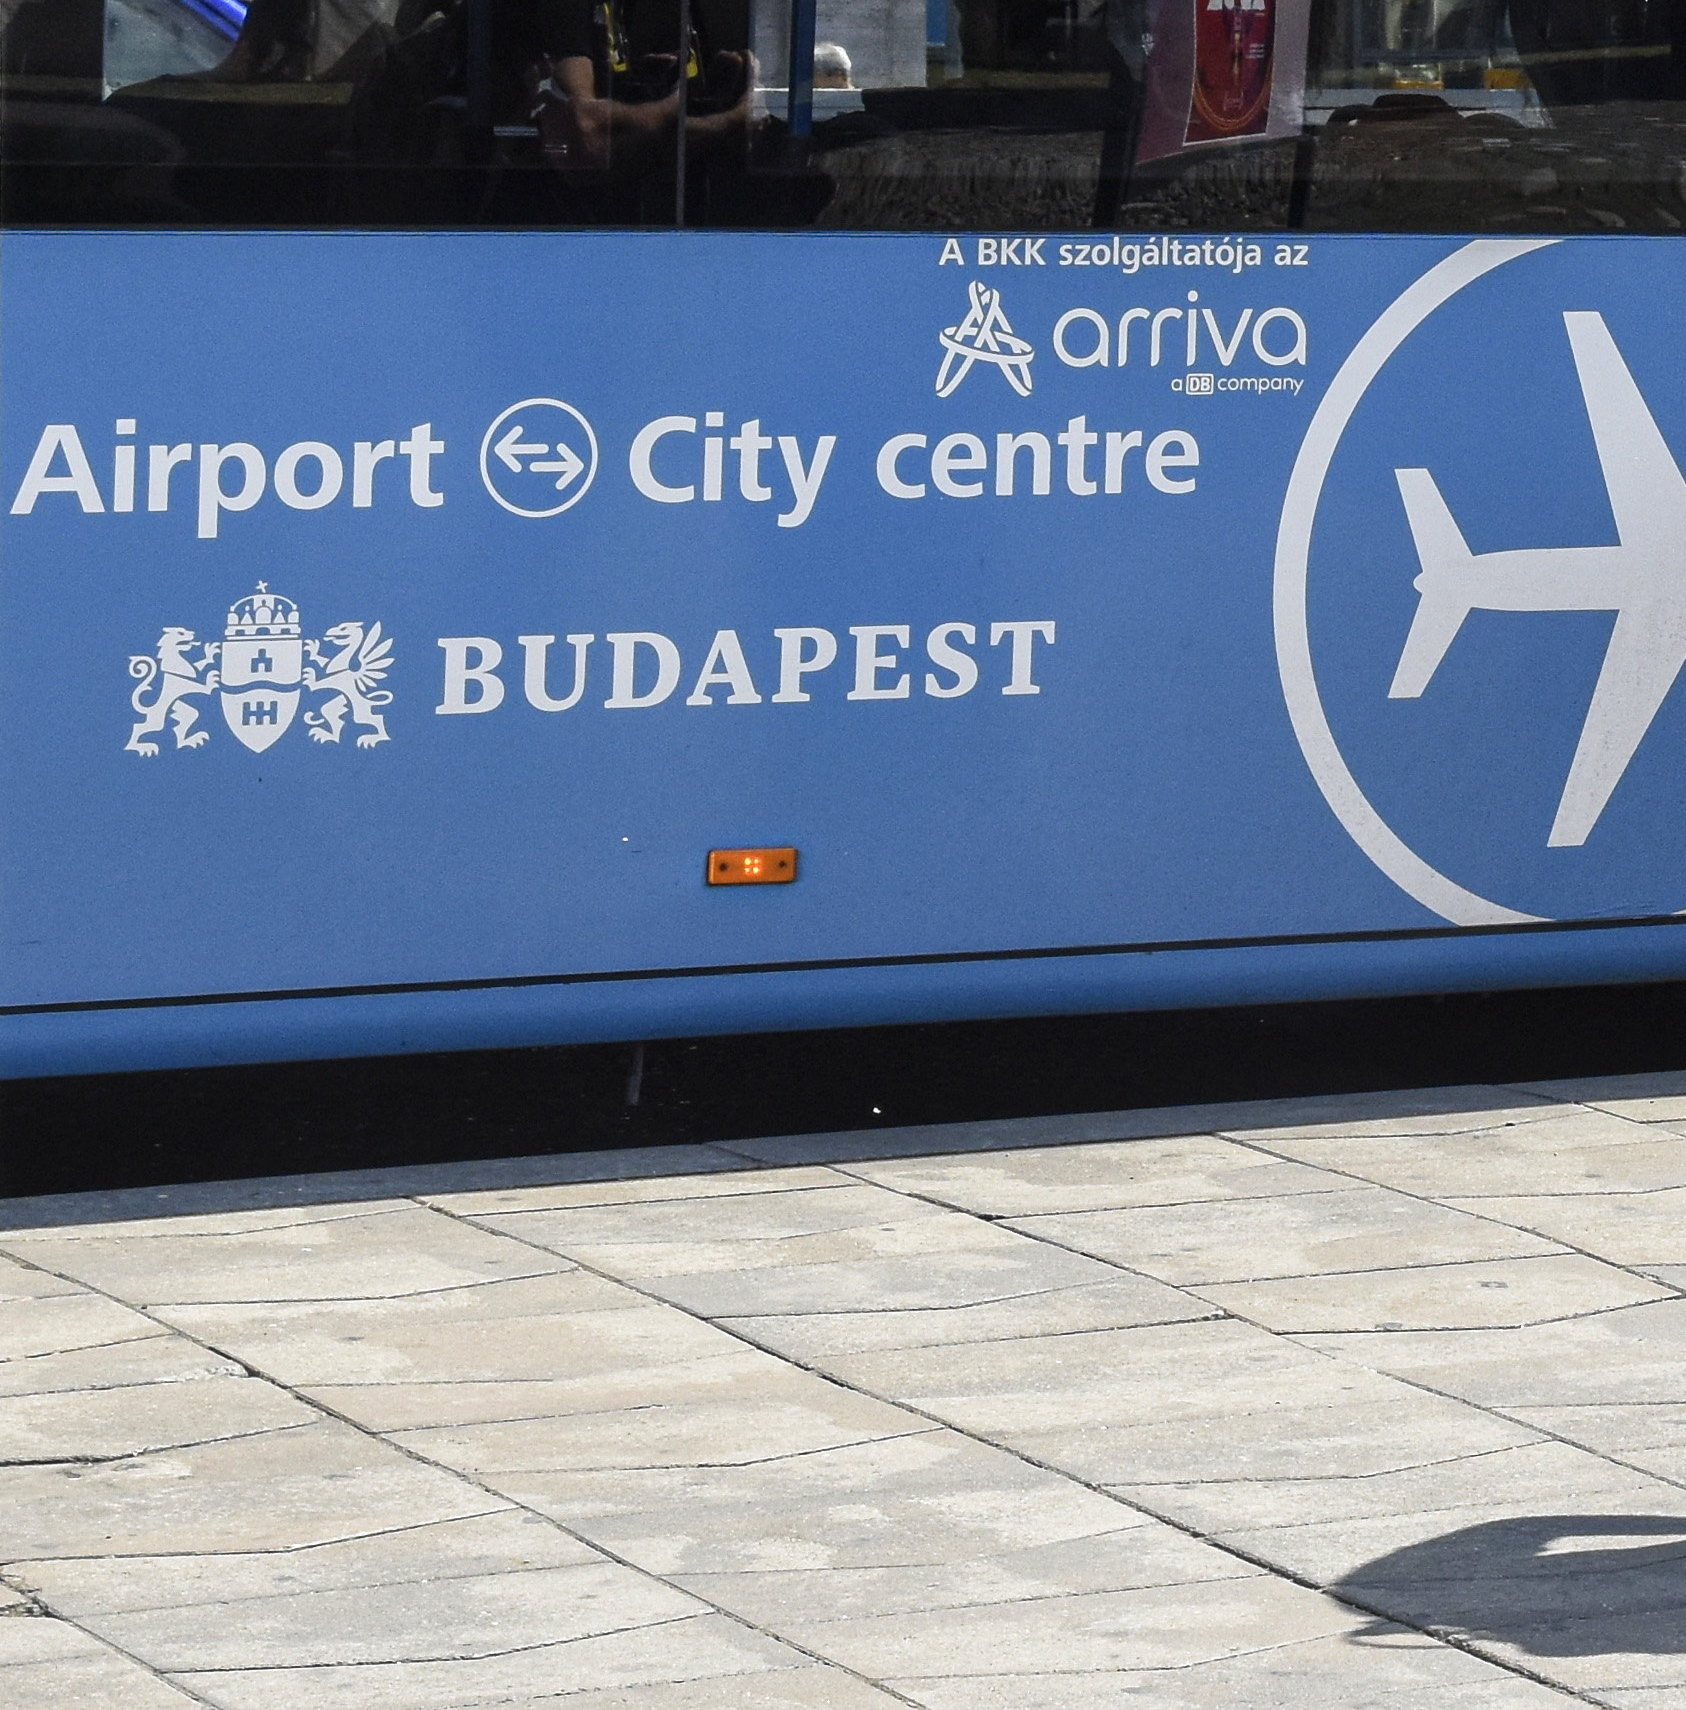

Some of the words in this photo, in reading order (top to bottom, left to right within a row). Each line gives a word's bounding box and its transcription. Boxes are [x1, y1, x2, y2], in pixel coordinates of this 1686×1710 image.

[938, 238, 965, 266] A
[977, 237, 1047, 266] BKK
[1058, 235, 1262, 275] szolgáltatója
[1274, 243, 1310, 266] az
[1052, 289, 1307, 368] arriva
[1171, 377, 1183, 392] a
[1190, 378, 1210, 390] DB
[1217, 376, 1305, 395] company
[9, 417, 445, 539] Airport
[628, 411, 837, 529] City
[876, 414, 1201, 501] centre
[435, 618, 1057, 717] BUDAPEST
